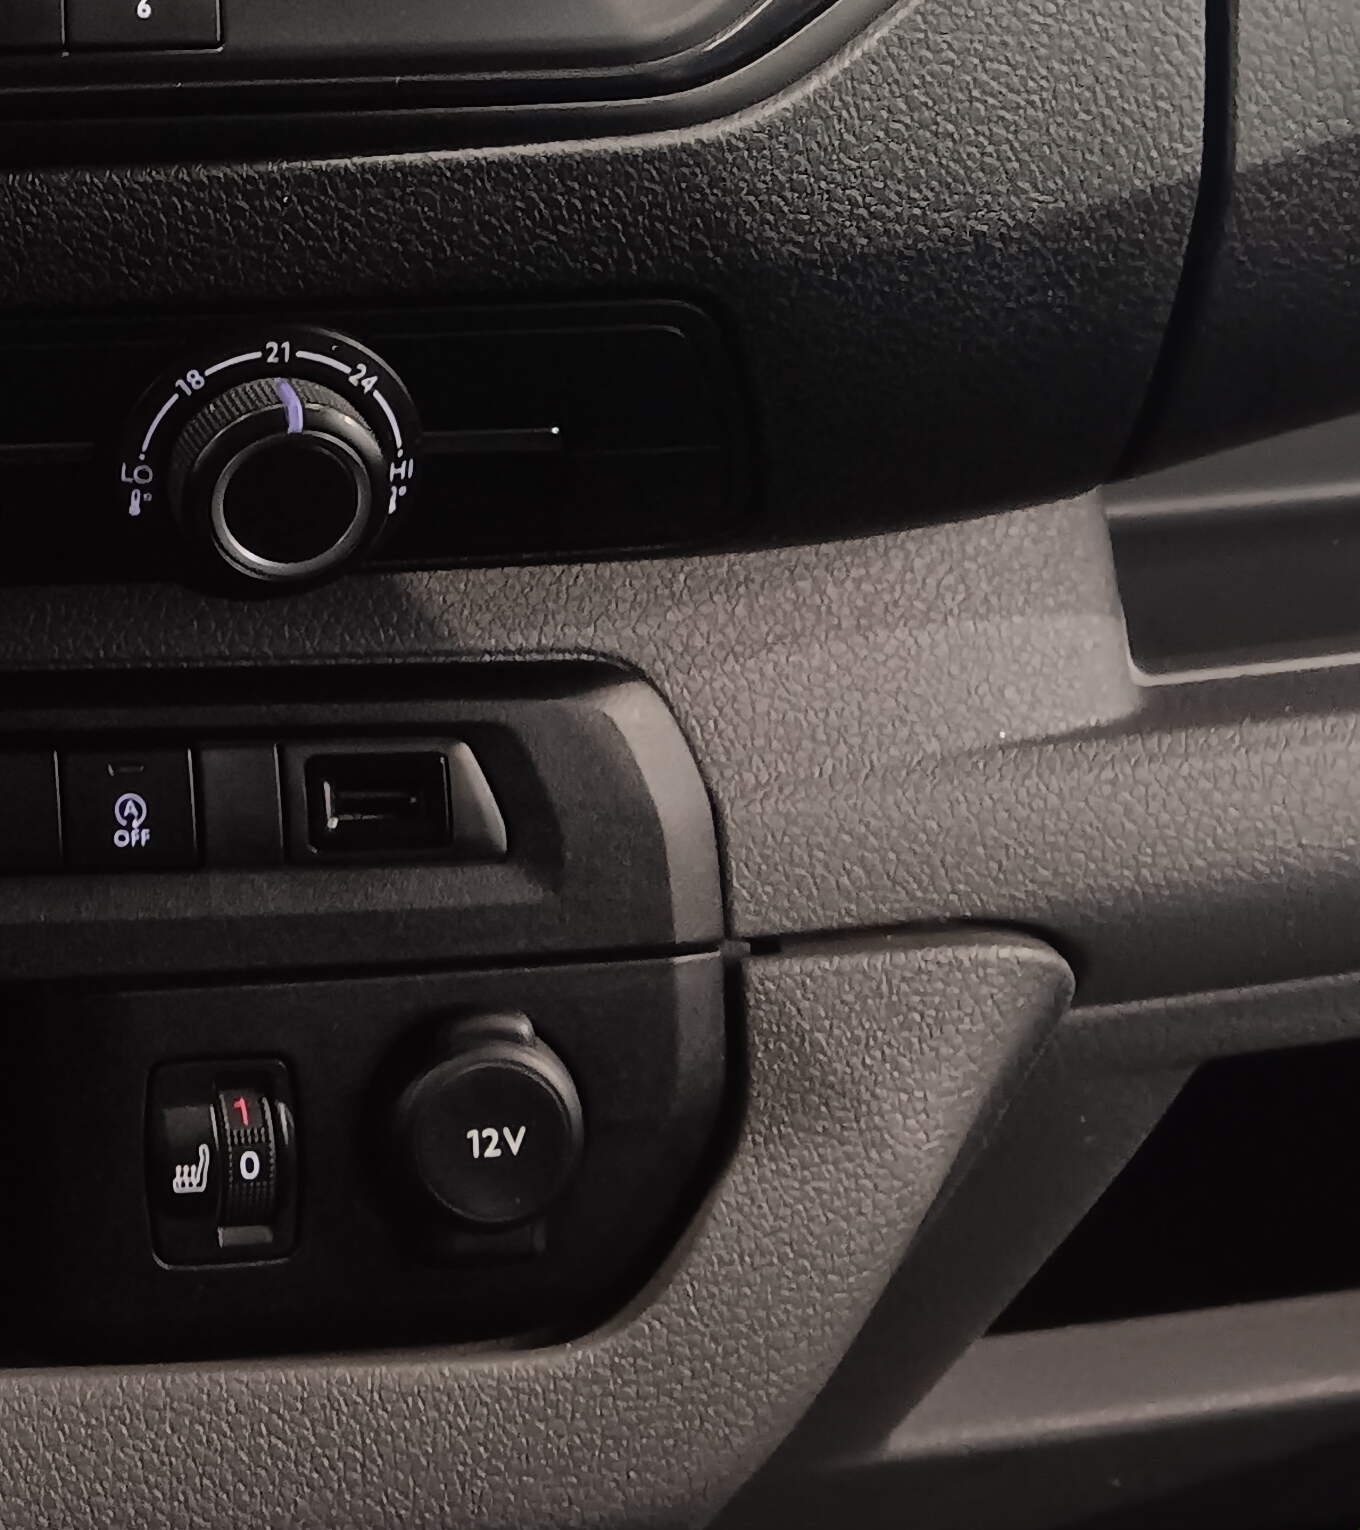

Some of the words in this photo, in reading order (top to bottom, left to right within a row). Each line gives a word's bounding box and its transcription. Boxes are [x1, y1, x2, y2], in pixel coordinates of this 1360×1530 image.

[265, 340, 290, 364] 21
[174, 369, 206, 397] 18
[348, 362, 379, 394] 24
[120, 461, 154, 485] LO
[388, 457, 415, 482] HI
[112, 828, 152, 849] OFF
[233, 1097, 249, 1126] 1
[466, 1125, 526, 1159] 12V
[239, 1150, 260, 1180] 0
